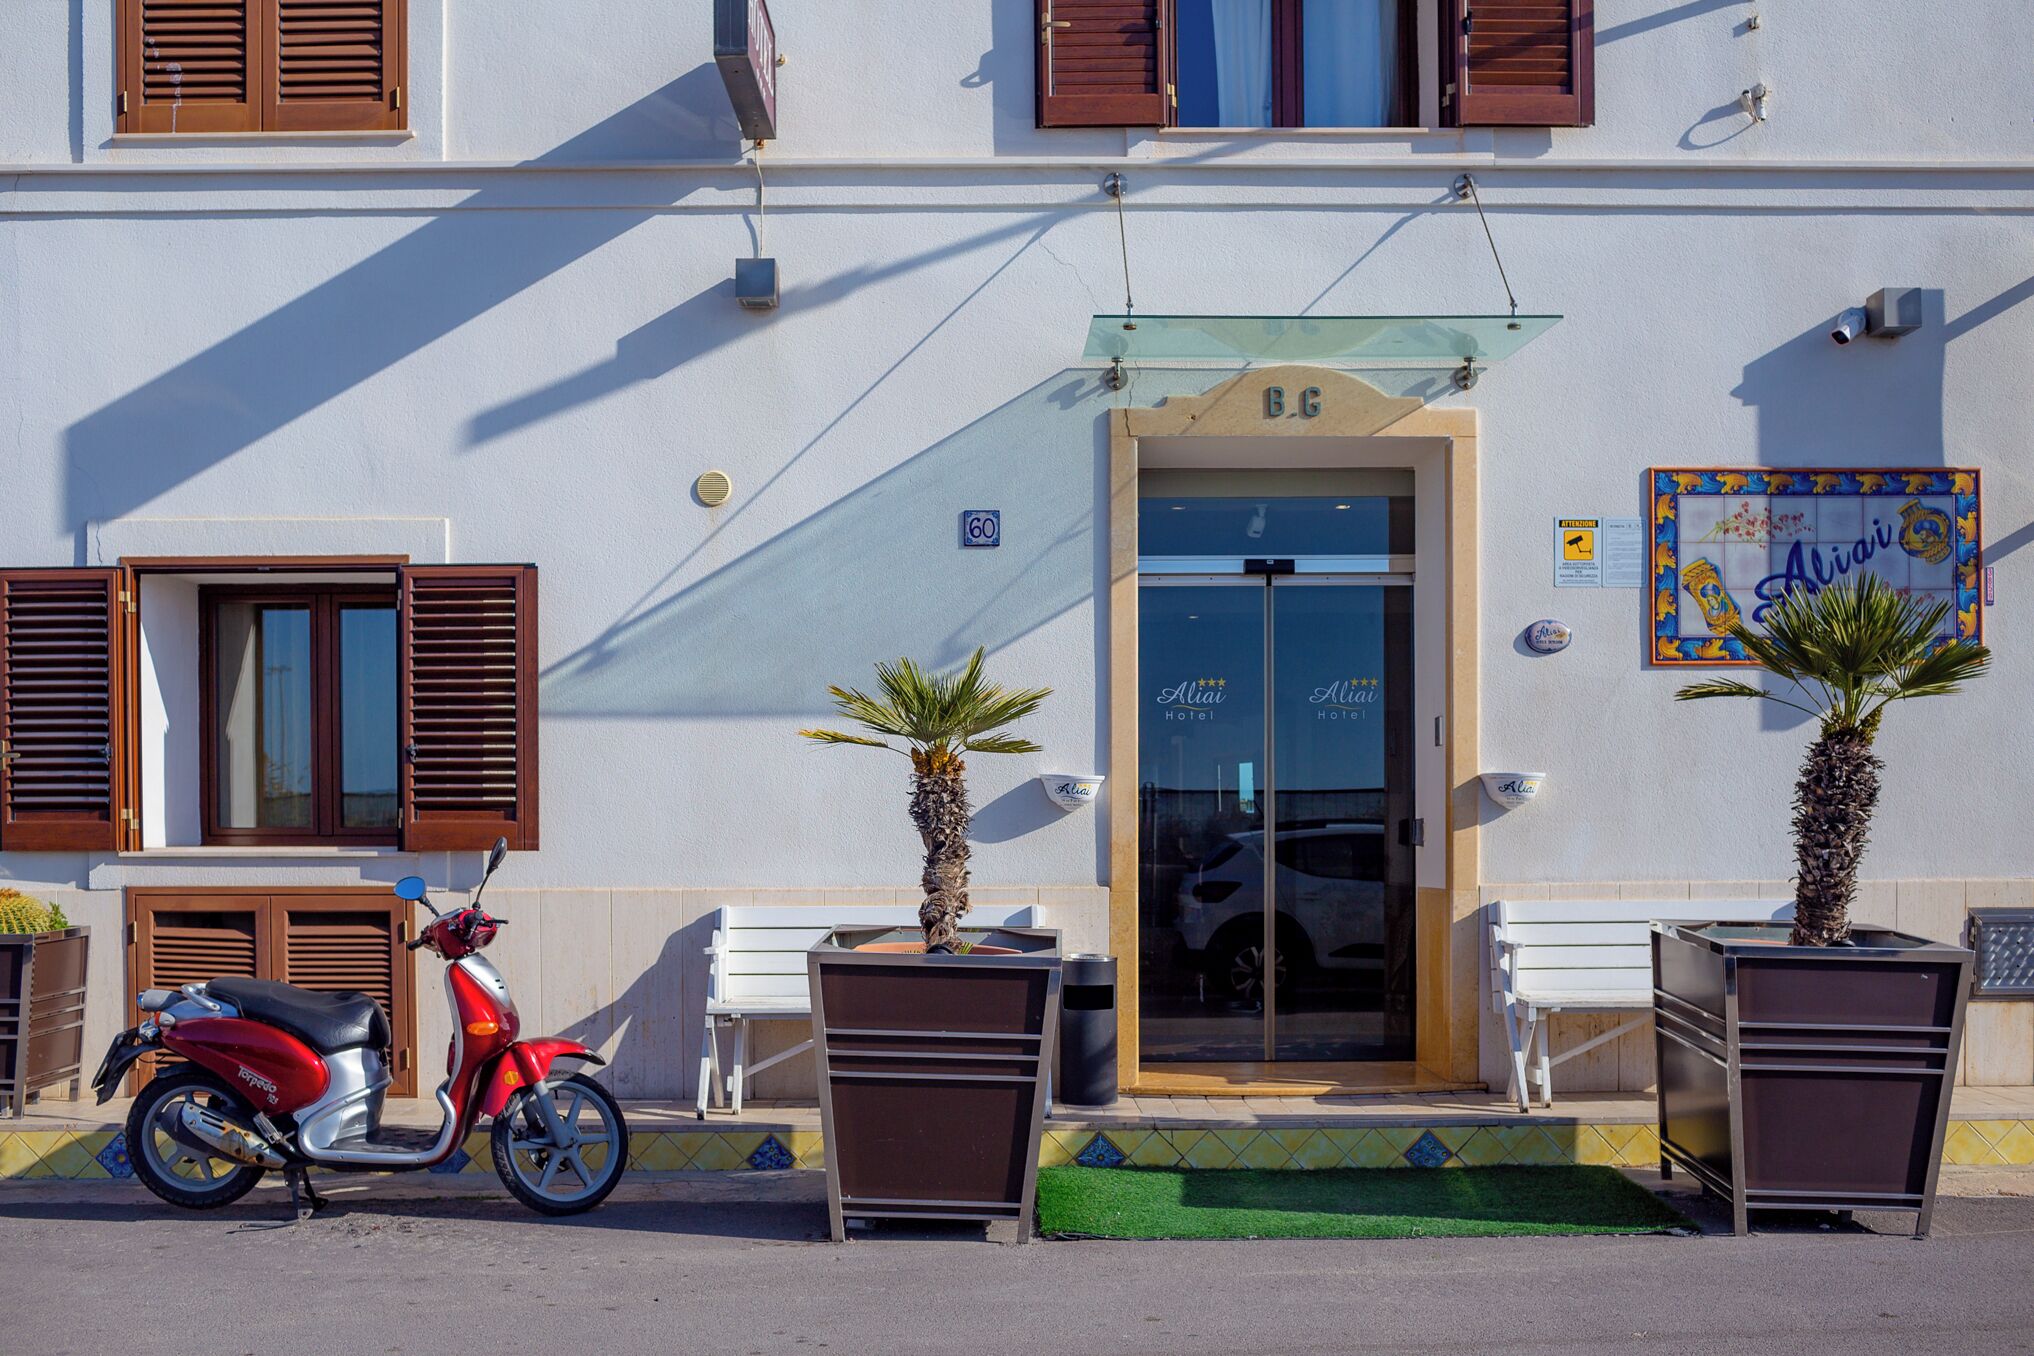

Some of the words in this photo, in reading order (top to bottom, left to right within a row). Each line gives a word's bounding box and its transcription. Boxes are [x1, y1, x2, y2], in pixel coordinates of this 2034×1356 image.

[969, 517, 996, 539] 60
[1561, 520, 1597, 528] ATTENZIONE
[1157, 681, 1227, 704] Aliai
[1309, 680, 1378, 703] Aliai
[1166, 710, 1213, 720] Hotel
[1318, 710, 1366, 720] Hotel
[238, 1065, 277, 1093] Torpedo
